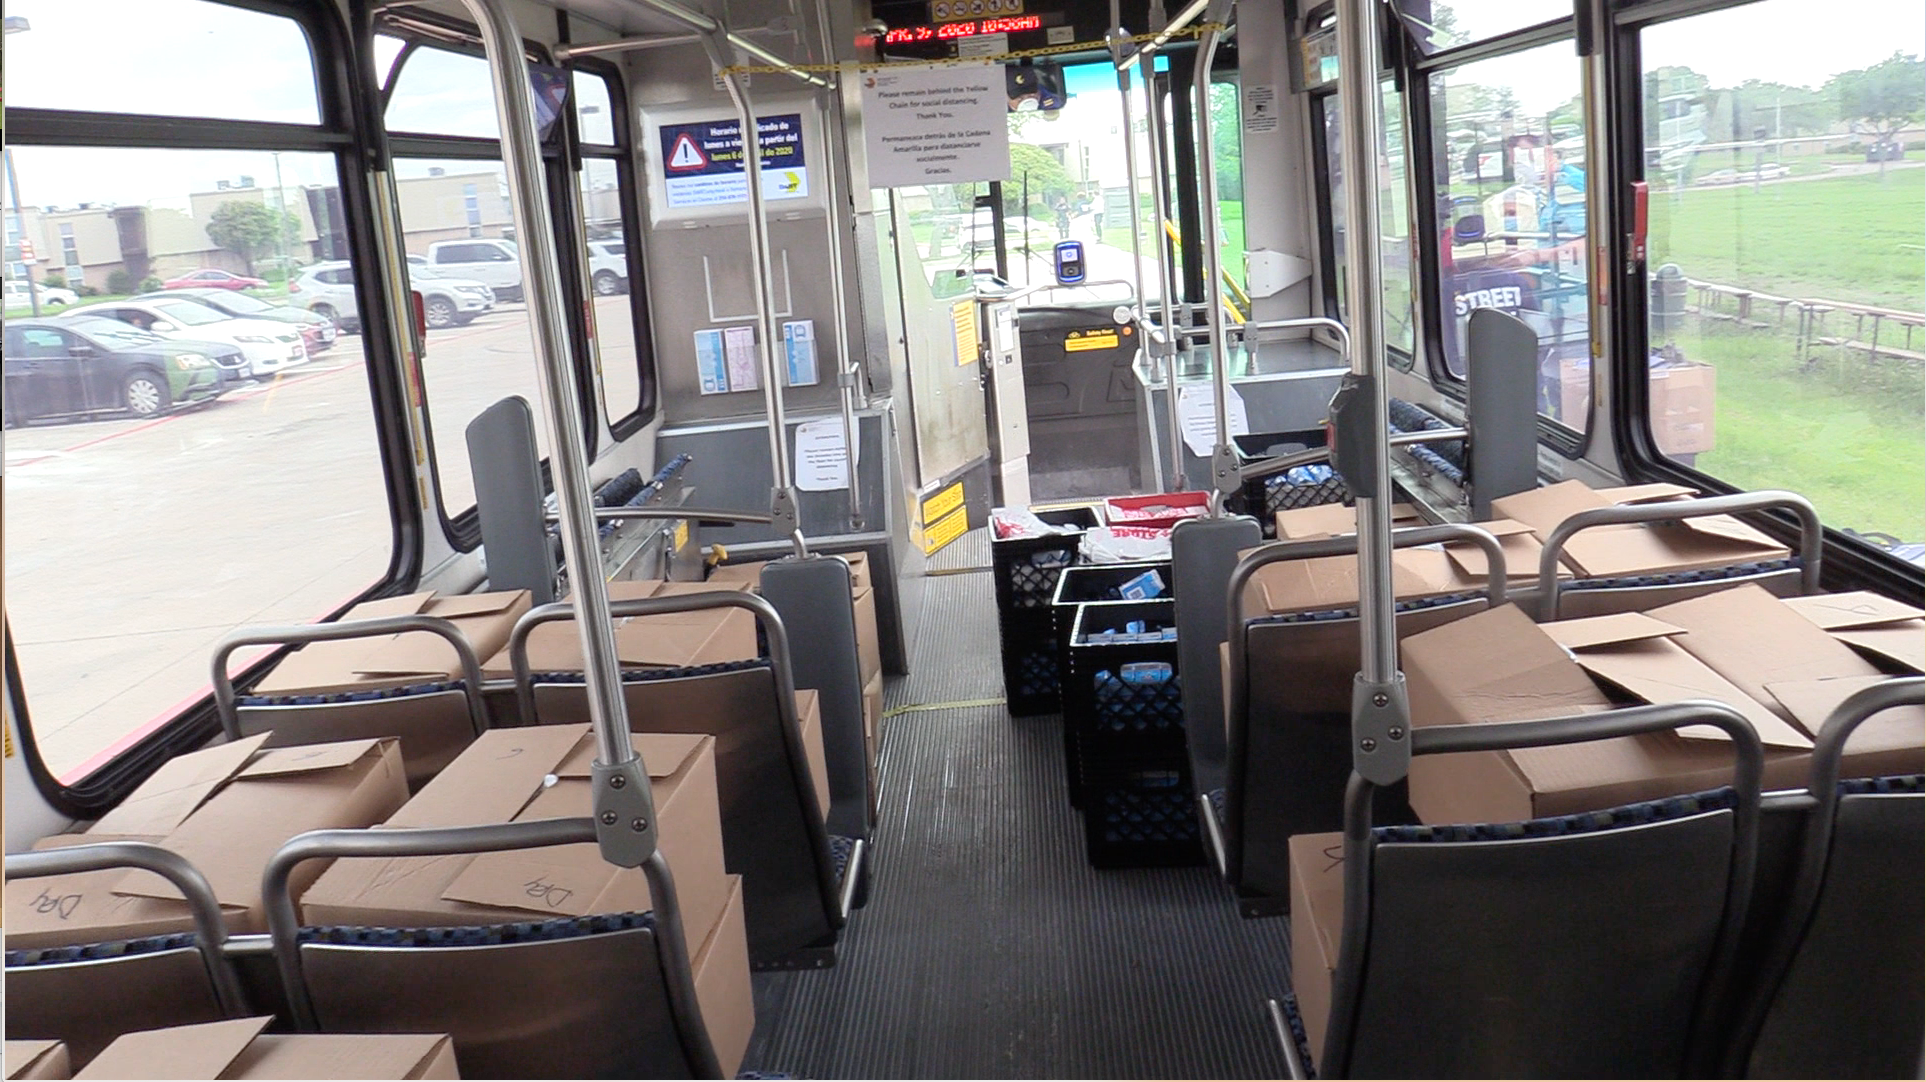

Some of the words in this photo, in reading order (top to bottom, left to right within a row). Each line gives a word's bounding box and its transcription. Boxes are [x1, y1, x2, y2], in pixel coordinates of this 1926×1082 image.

[927, 87, 951, 95] behind
[889, 101, 908, 109] Chain
[921, 99, 941, 107] social
[709, 126, 738, 137] Horario
[779, 121, 790, 130] de
[703, 140, 724, 150] lunes
[765, 134, 785, 146] partir
[785, 132, 798, 142] del
[893, 145, 922, 153] Amarilla
[923, 144, 939, 152] para
[940, 142, 981, 150] distanciarse
[711, 152, 731, 162] lunes
[765, 147, 775, 157] de
[775, 146, 793, 156] 2020
